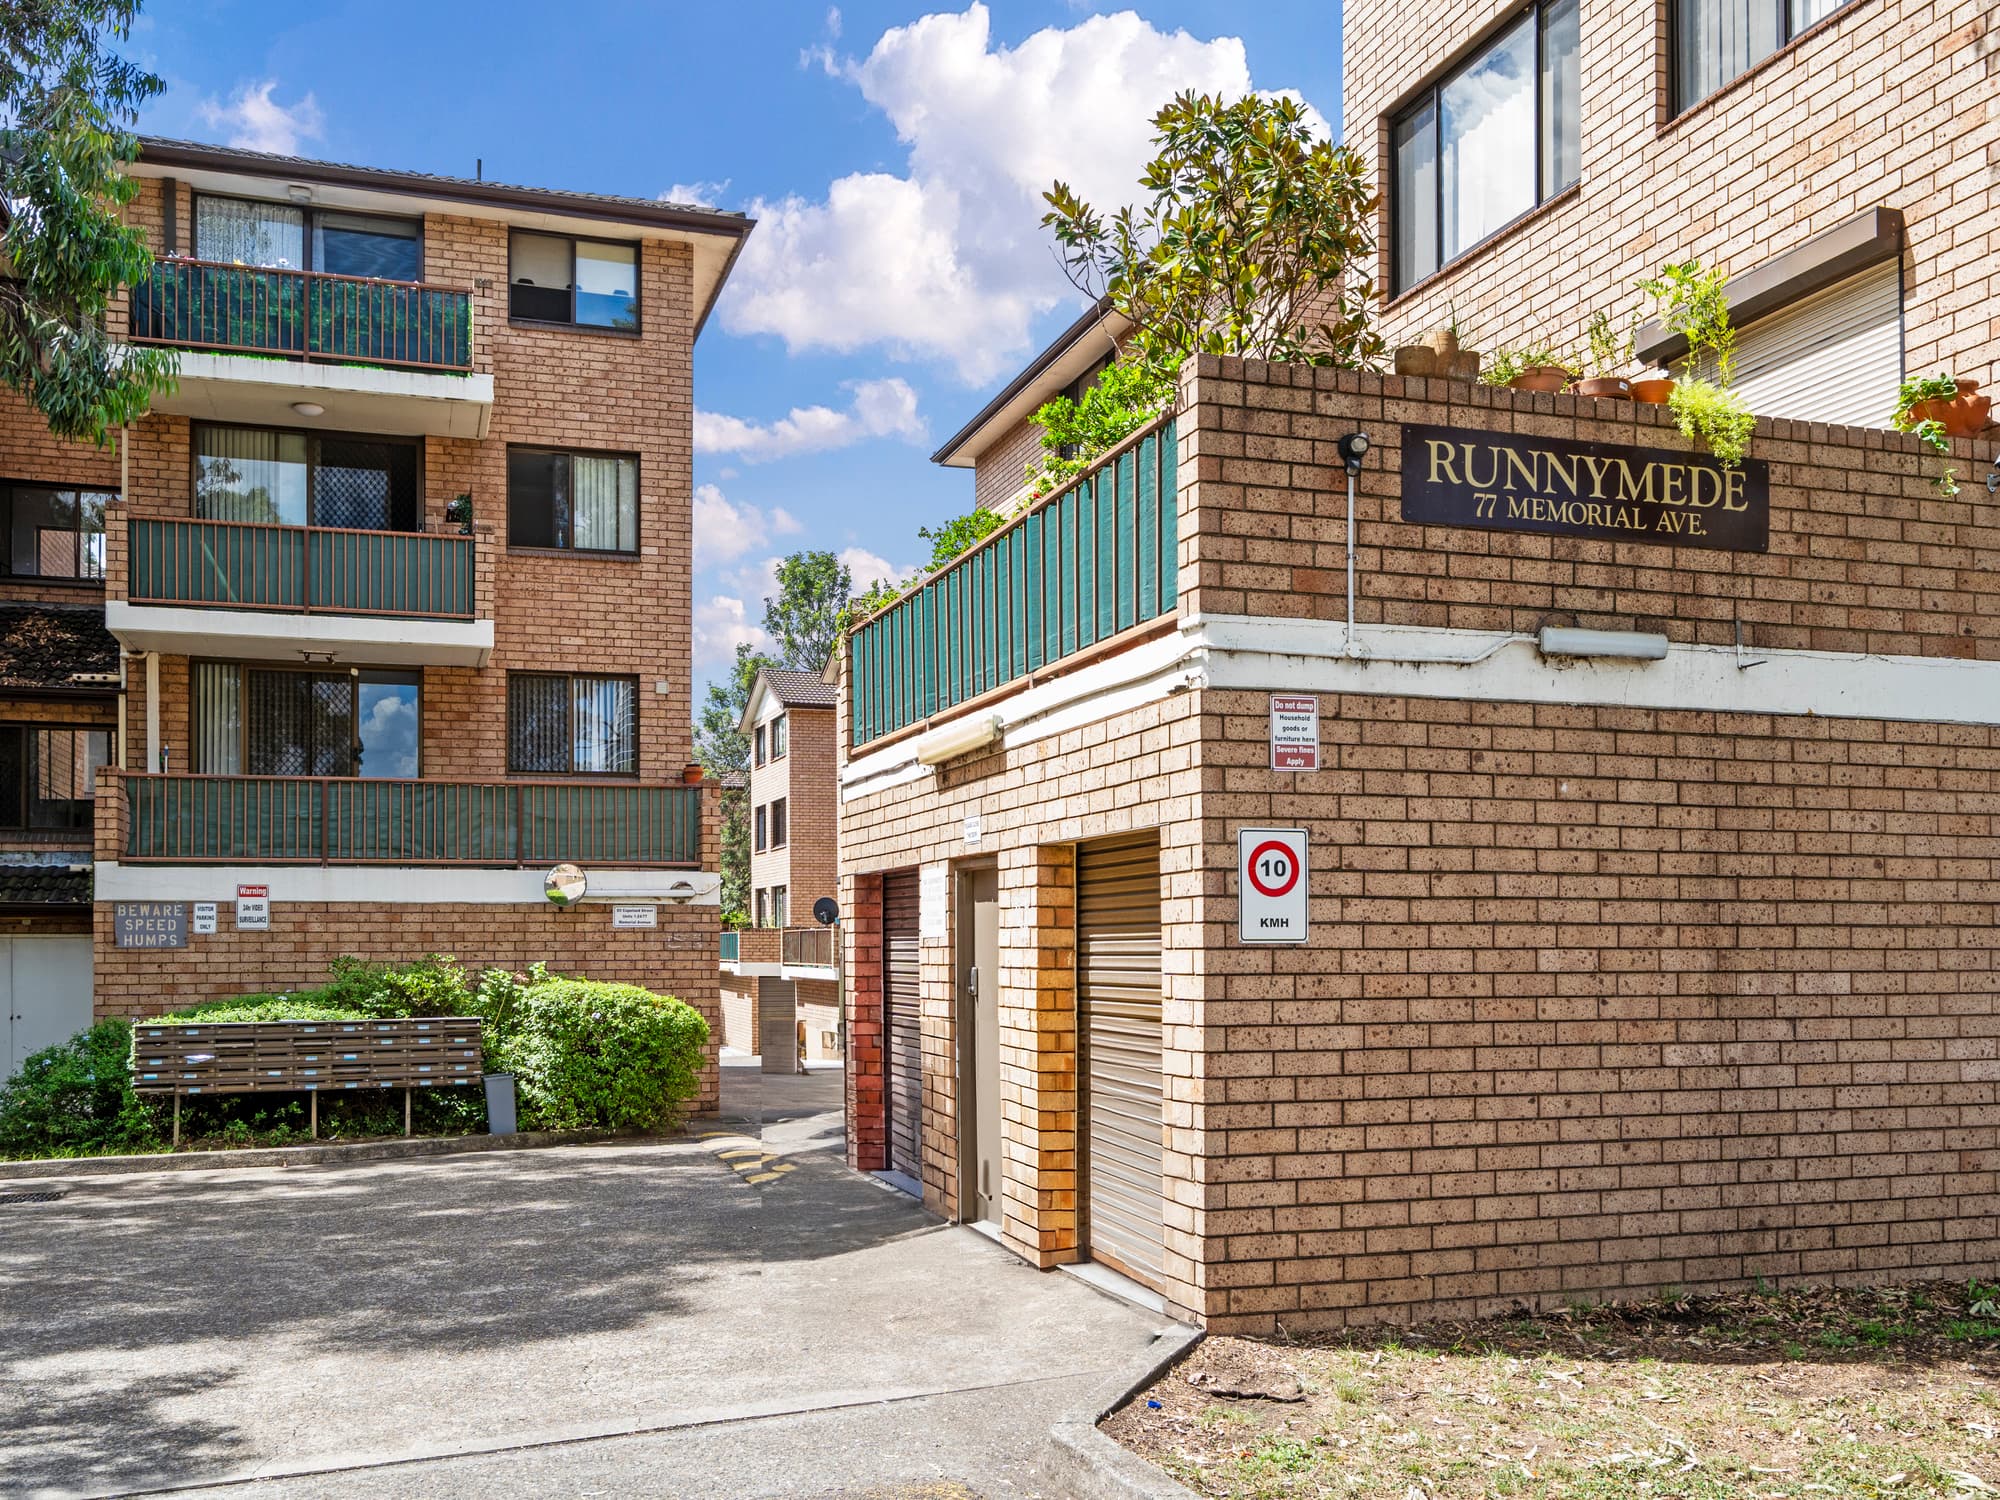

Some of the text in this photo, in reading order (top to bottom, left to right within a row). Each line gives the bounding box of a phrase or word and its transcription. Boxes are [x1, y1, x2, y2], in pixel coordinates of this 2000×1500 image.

[1424, 440, 1748, 512] RUNNYMEDE
[1473, 493, 1707, 536] 77 MEMORIAL AVE.
[1275, 701, 1283, 709] Do
[1297, 702, 1313, 712] dump
[1287, 757, 1304, 766] Apply
[1260, 860, 1286, 877] 10
[239, 887, 267, 897] Warning
[118, 904, 183, 917] BEWARE
[125, 919, 177, 931] SPEED
[1260, 918, 1289, 927] KMH
[124, 934, 177, 946] HUMPS
